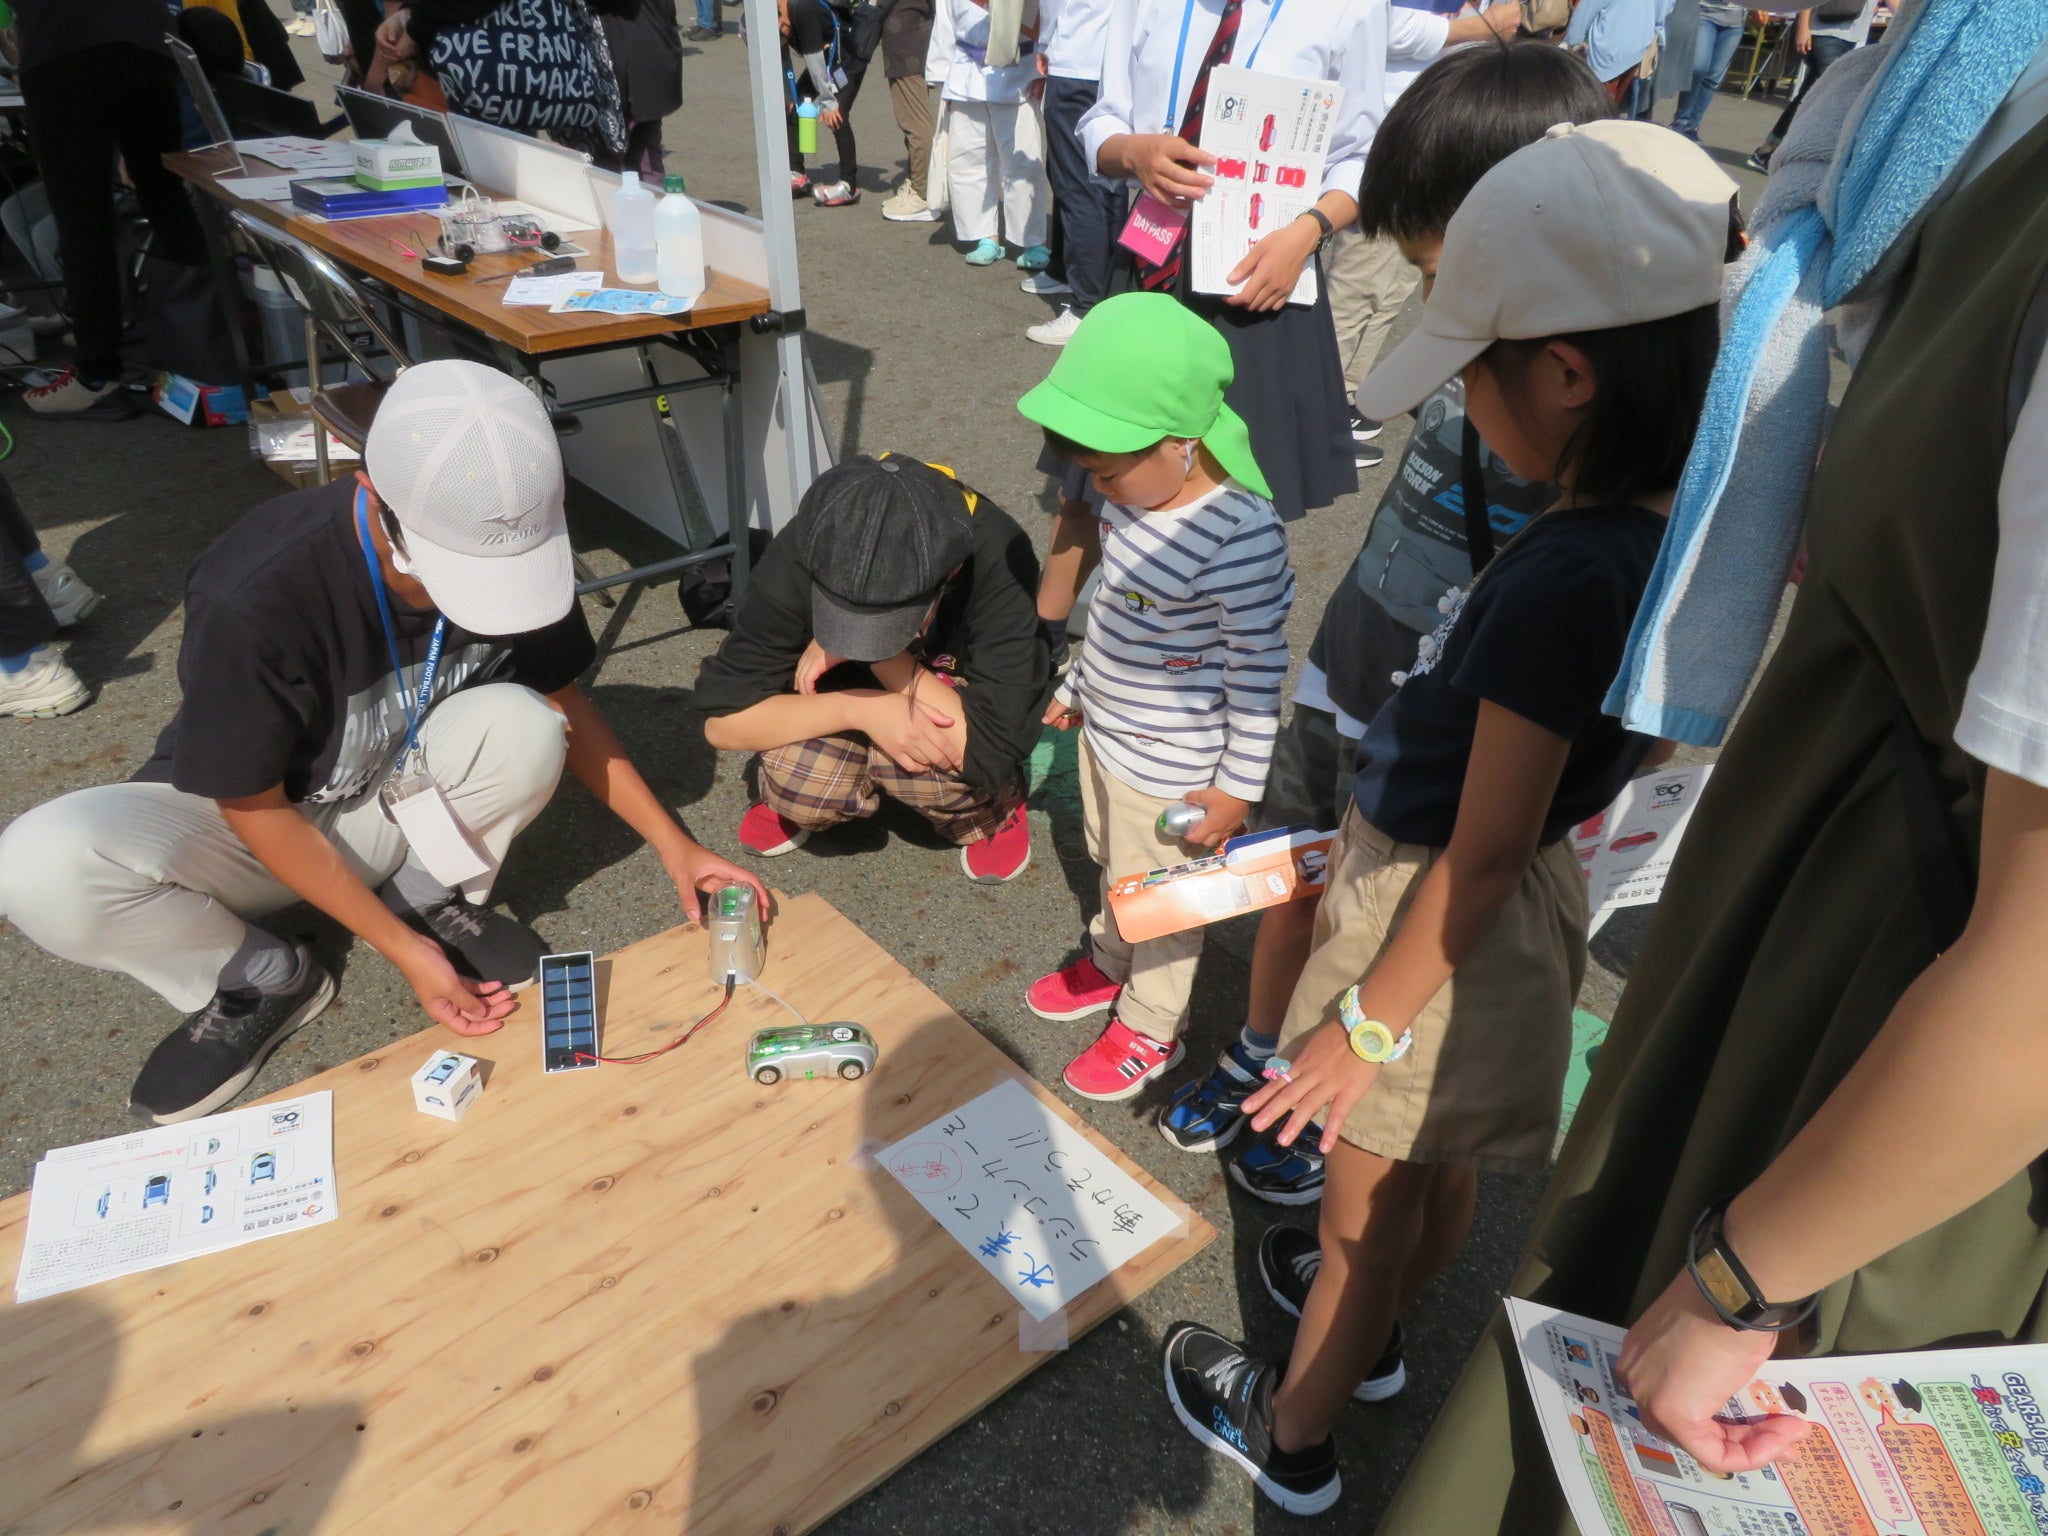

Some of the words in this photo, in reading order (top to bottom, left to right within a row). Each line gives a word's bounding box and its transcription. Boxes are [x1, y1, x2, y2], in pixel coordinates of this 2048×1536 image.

[475, 0, 547, 30] AKES
[430, 29, 492, 64] OVE
[497, 62, 519, 93] IT
[464, 90, 523, 126] PEN
[528, 100, 600, 127] MIND
[427, 638, 440, 661] JAPAN
[418, 662, 435, 699] FOOTBALL
[1214, 1421, 1237, 1443] ONE
